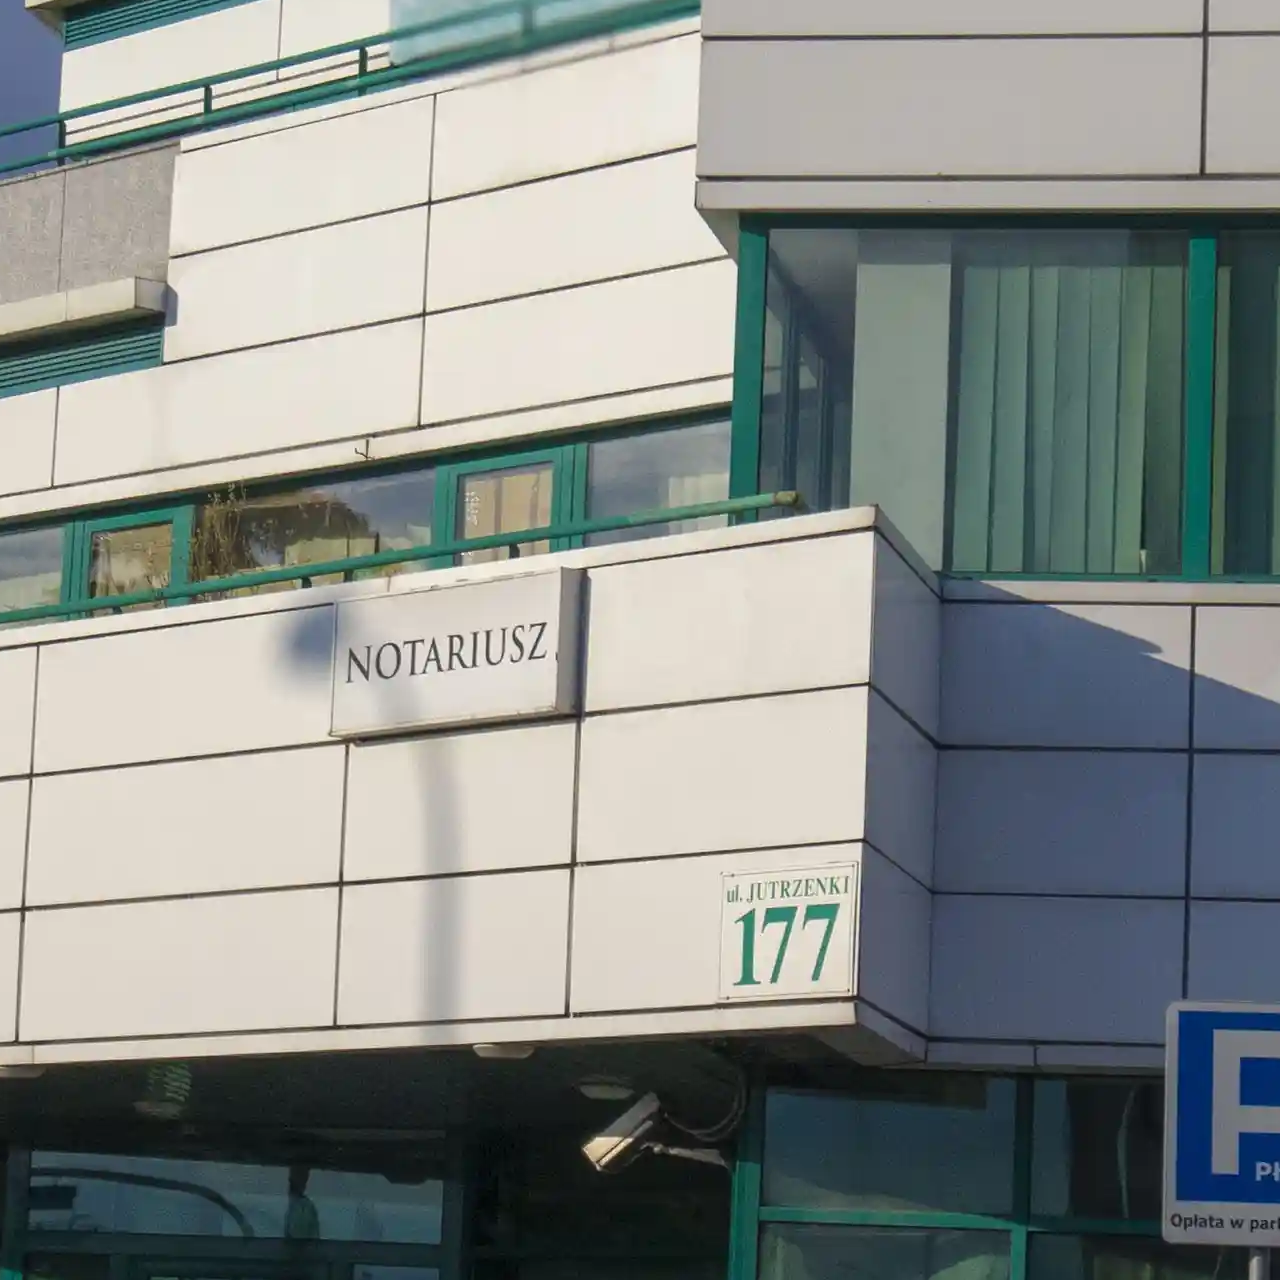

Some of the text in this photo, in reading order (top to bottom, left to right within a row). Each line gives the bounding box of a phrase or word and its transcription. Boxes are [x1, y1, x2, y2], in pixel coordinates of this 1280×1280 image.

[346, 622, 548, 683] NOTARIUSZ
[727, 875, 849, 903] ul. JUTRZENKI
[733, 903, 840, 986] 177
[1170, 1213, 1225, 1231] Opłata
[1231, 1218, 1244, 1230] w
